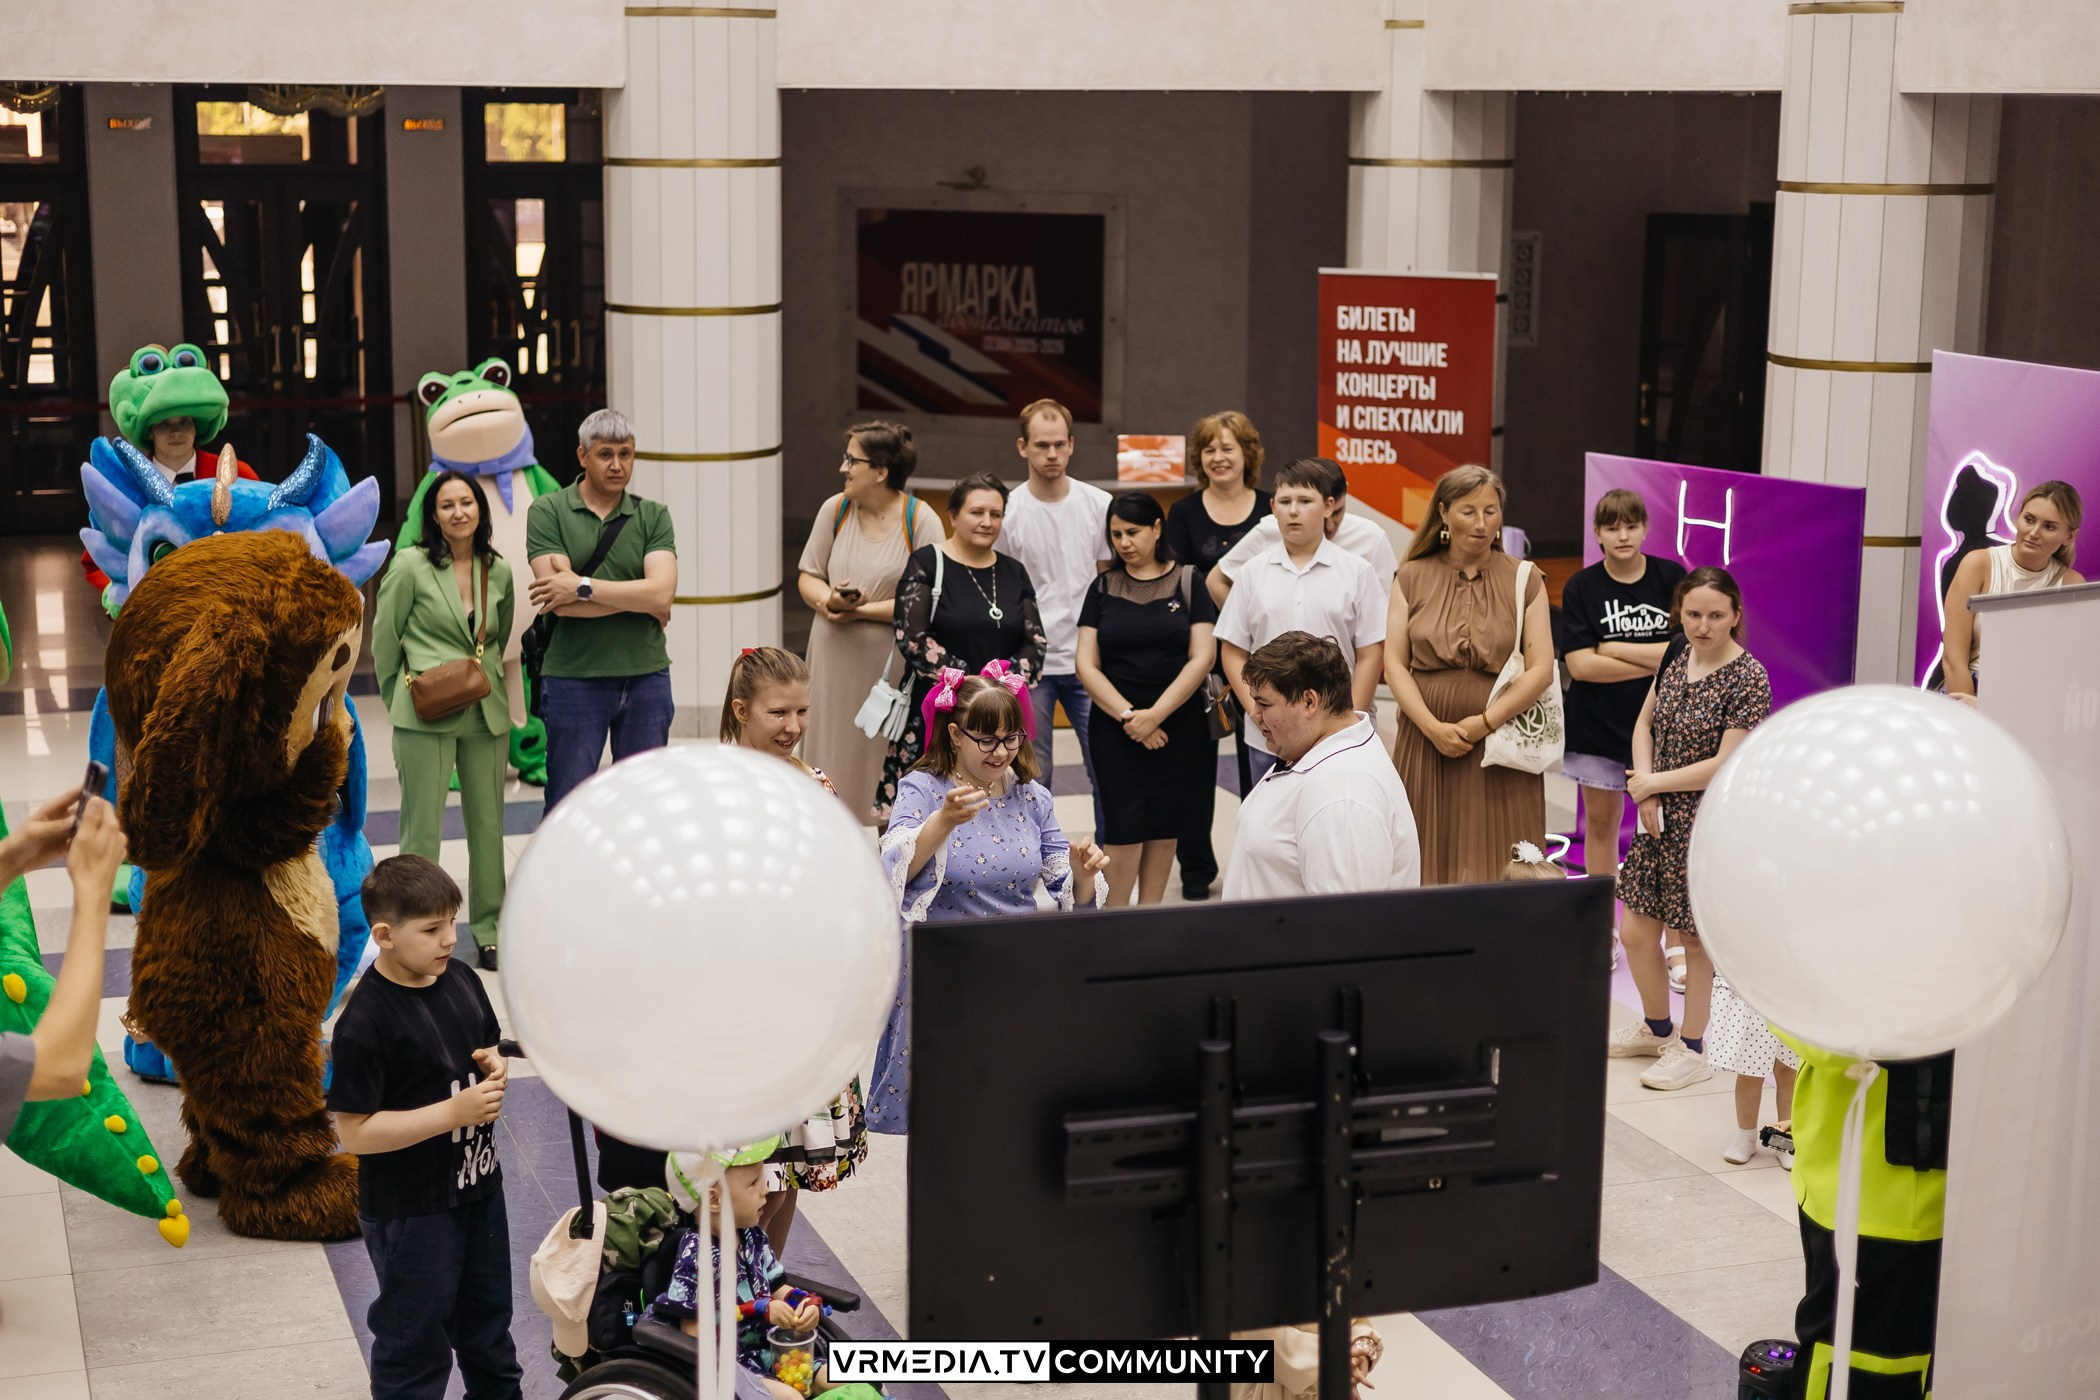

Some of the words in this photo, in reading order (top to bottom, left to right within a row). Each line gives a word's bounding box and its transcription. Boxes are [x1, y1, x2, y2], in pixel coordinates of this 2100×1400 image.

[901, 261, 1039, 318] ЯРМАРКА
[1336, 305, 1416, 333] БИЛЕТЫ
[1336, 338, 1363, 364] НА
[1365, 340, 1448, 368] ЛУЧШИЕ
[1336, 372, 1437, 401] КОНЦЕРТЫ
[1336, 405, 1350, 430] И
[1353, 405, 1464, 436] СПЕКТАКЛИ
[1335, 438, 1398, 465] ЗДЕСЬ
[1600, 599, 1669, 633] House
